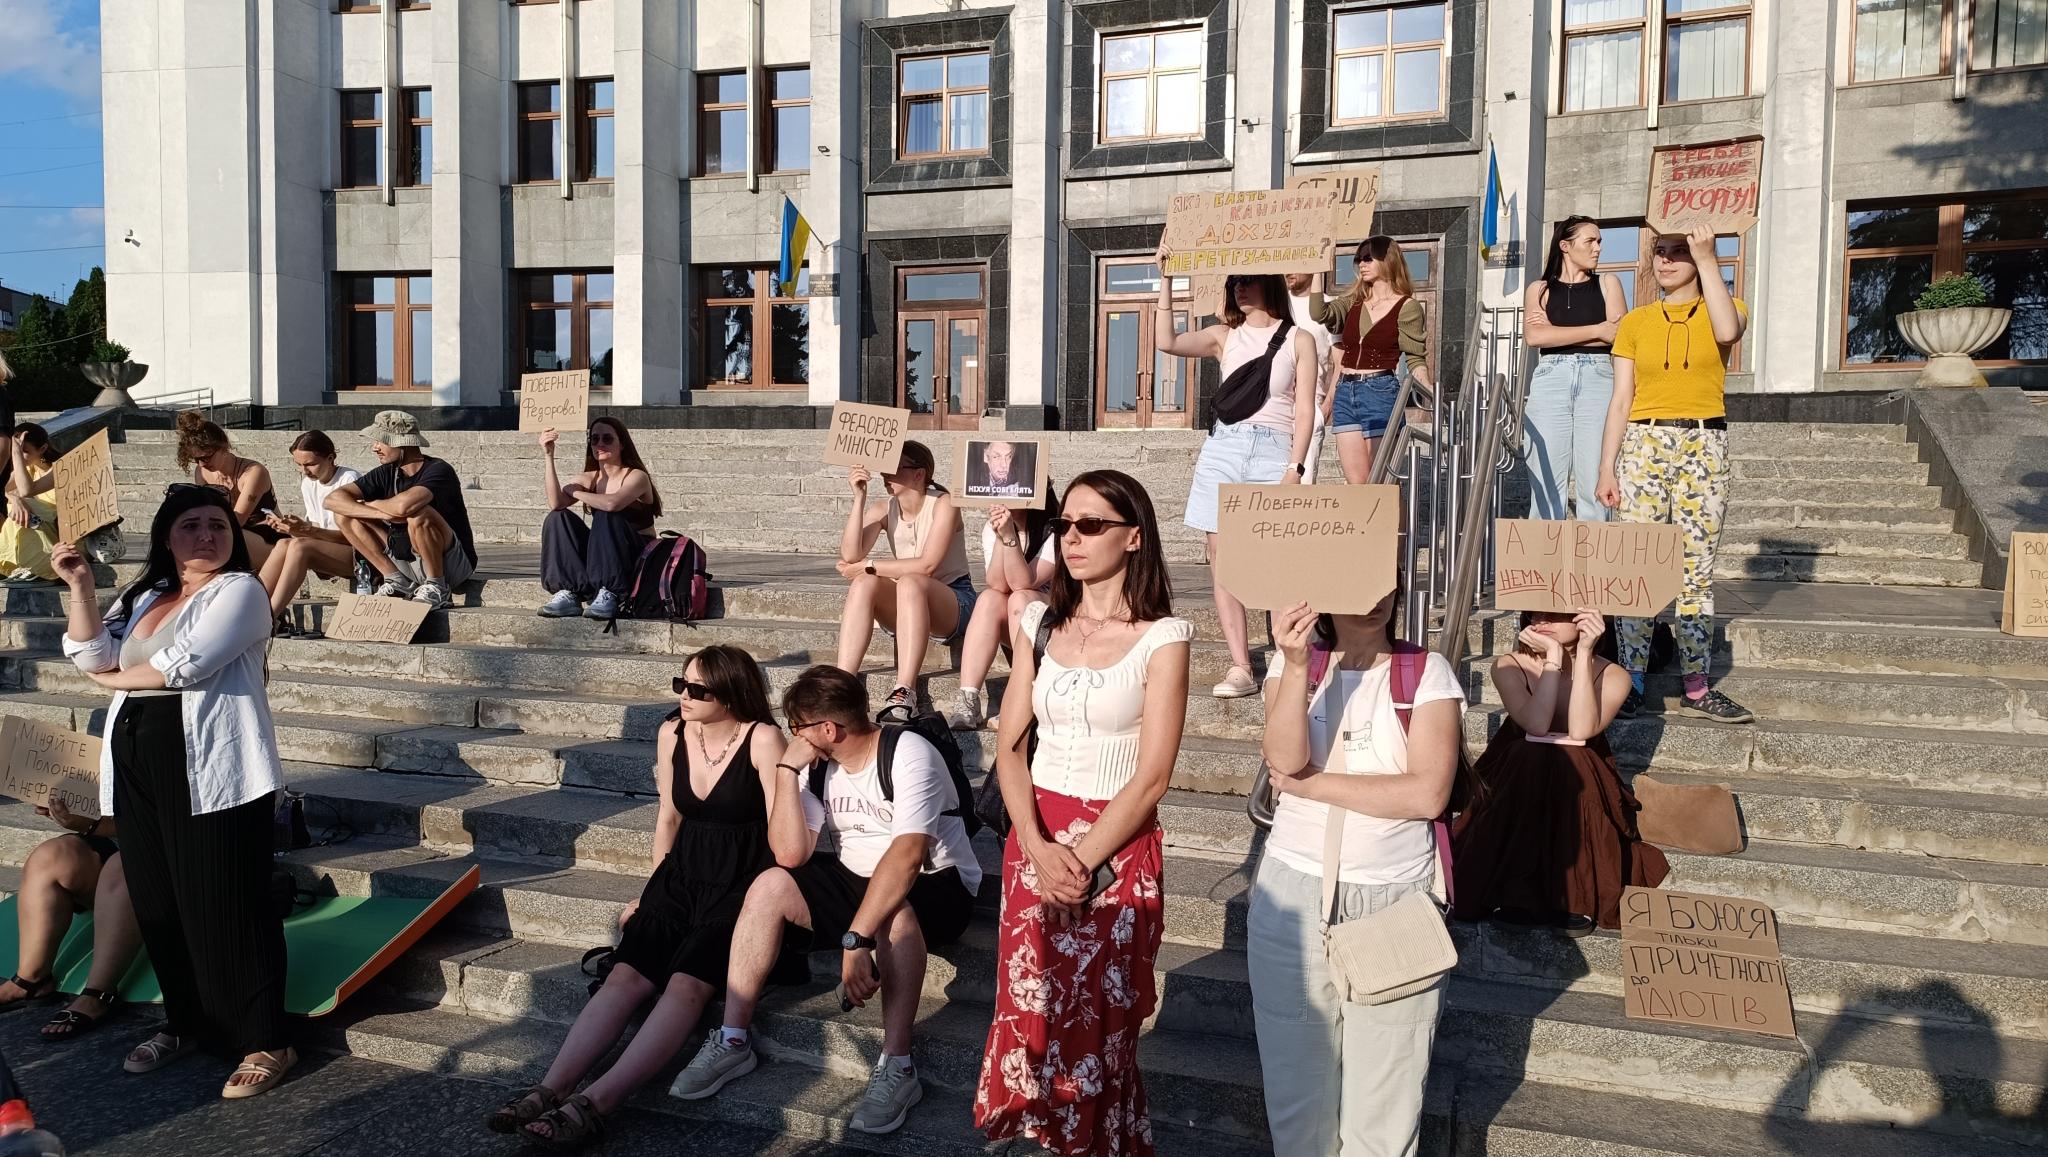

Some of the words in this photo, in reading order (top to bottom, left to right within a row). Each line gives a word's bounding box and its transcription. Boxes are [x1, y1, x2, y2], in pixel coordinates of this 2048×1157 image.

[1196, 219, 1292, 247] ДОХУЯ
[524, 373, 587, 393] ПОВЕРНІТЬ
[838, 411, 899, 438] ФЕДОРОВ
[833, 433, 893, 459] МІНІСТР
[55, 444, 100, 489] ВІЙНА
[64, 465, 114, 511] КАНІКУЛ
[968, 485, 990, 493] НІХУЯ
[69, 491, 117, 540] НЕМАЄ
[1505, 521, 1525, 555] А
[1543, 523, 1563, 556] У
[1574, 524, 1677, 570] ВІЙНИ
[1500, 568, 1545, 590] НЕМА
[1550, 568, 1652, 609] КАНІКУЛ
[351, 594, 392, 618] ВІЙНА
[824, 796, 893, 823] MILANO
[1627, 891, 1652, 926] Я
[1666, 894, 1768, 939] БОЮСЯ
[1655, 931, 1718, 949] ТІЛЬКИ
[1630, 945, 1784, 986] ПРИЧЕТНОСТІ
[1630, 975, 1650, 986] ДО
[1637, 986, 1767, 1025] ІДІОТІВ
